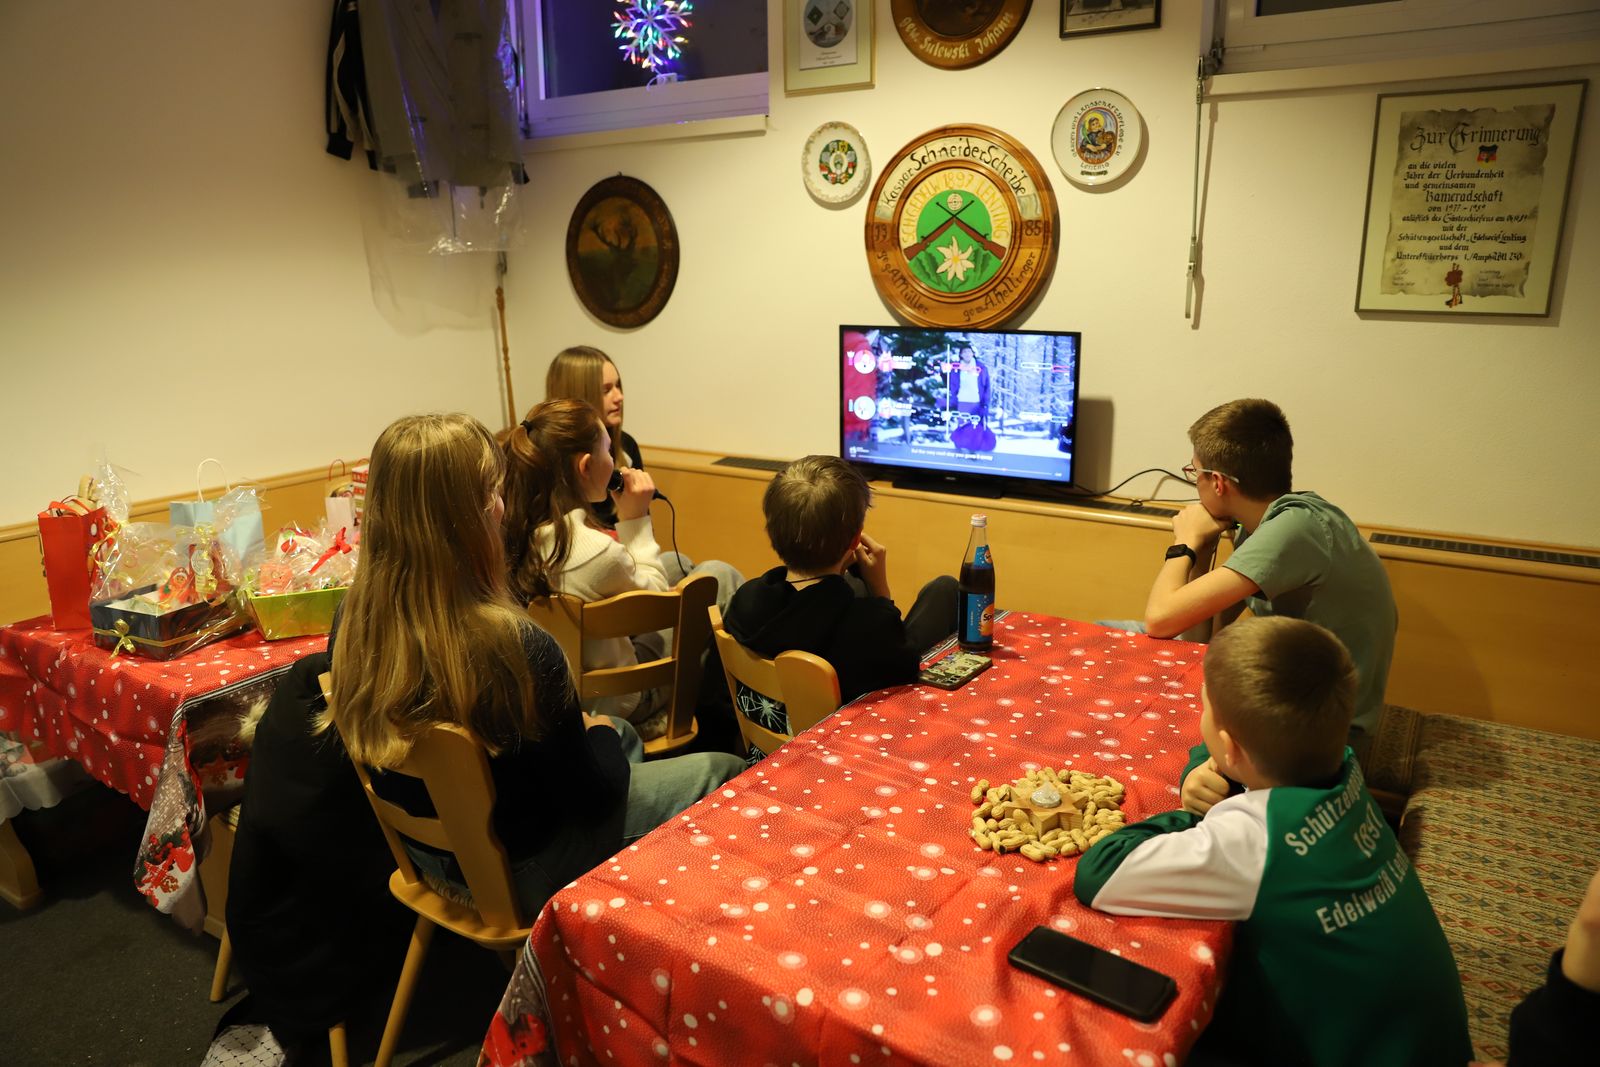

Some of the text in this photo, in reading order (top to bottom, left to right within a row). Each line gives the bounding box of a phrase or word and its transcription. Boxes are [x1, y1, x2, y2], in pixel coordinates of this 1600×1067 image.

[920, 36, 970, 59] Sulewski
[975, 11, 1014, 54] Johann
[1410, 122, 1540, 153] Zur Erinnerung
[1428, 171, 1440, 179] der
[1433, 160, 1456, 169] vielen
[1315, 868, 1397, 934] Edelweiß
